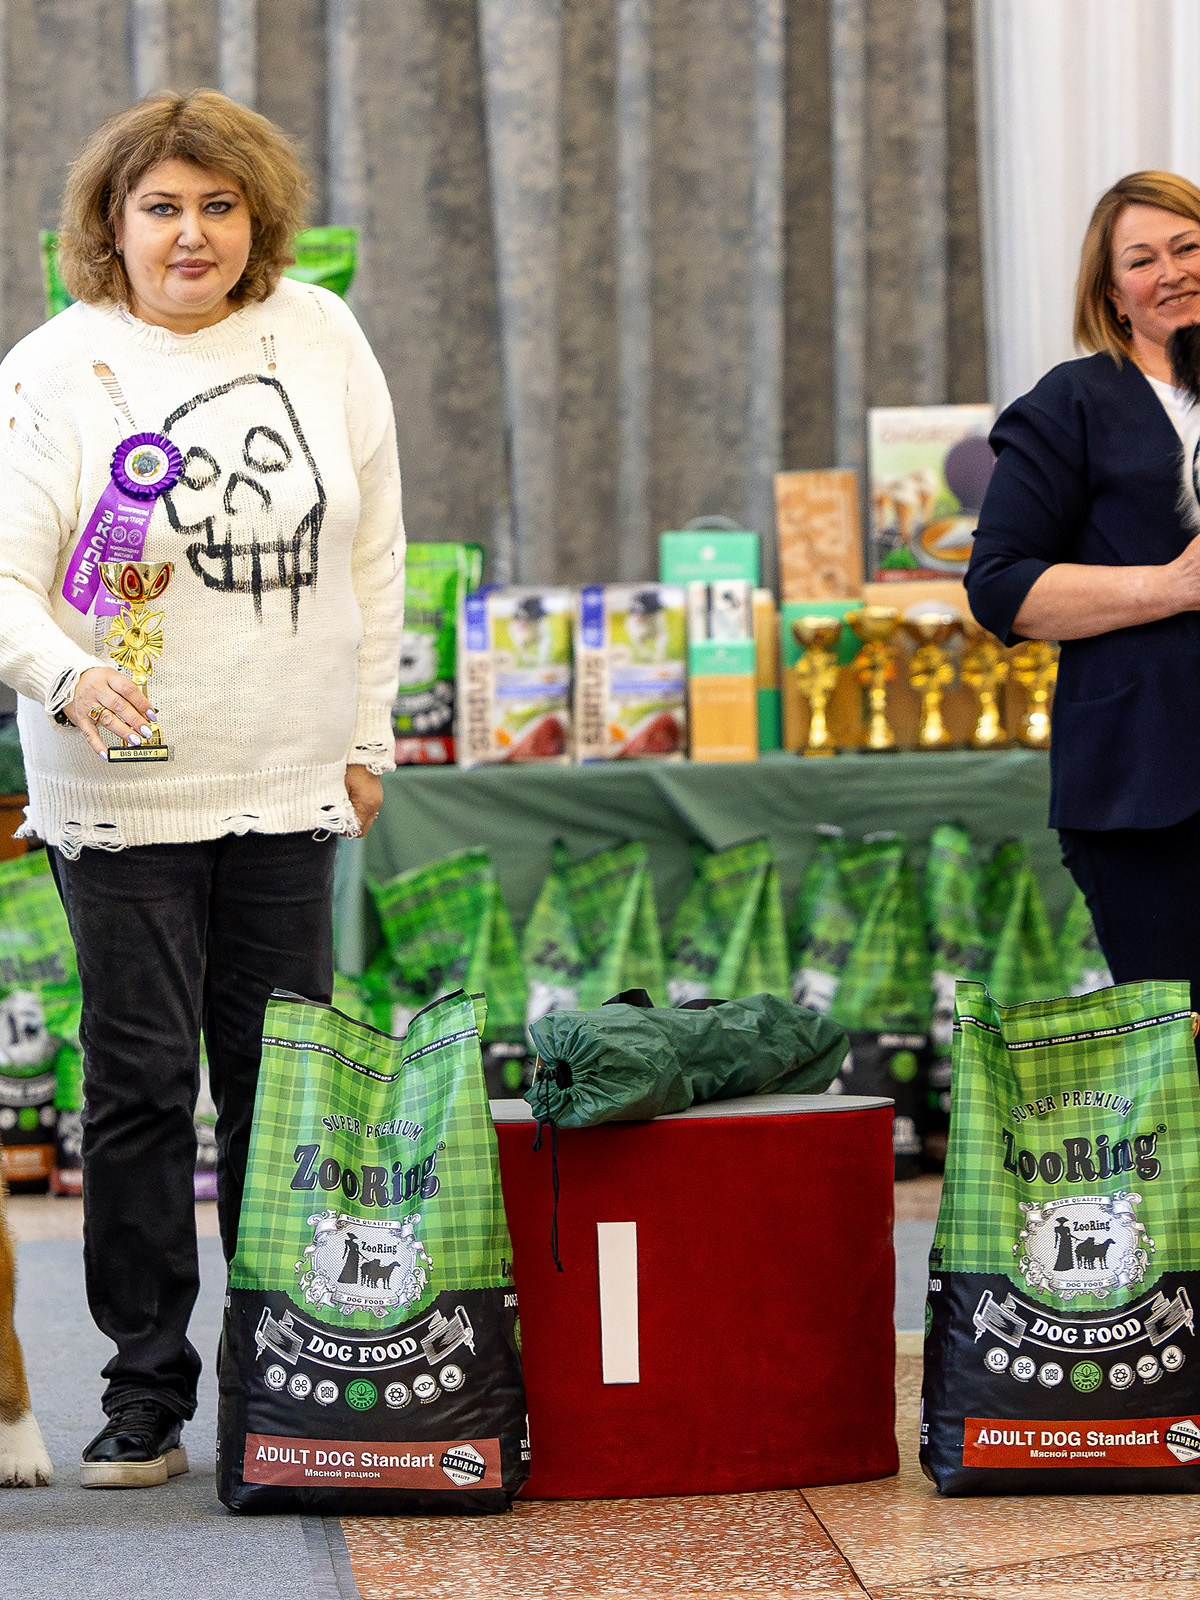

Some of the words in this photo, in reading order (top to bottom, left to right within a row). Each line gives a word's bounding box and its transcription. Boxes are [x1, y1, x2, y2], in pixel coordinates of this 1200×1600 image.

[72, 509, 115, 598] ЭКСПЕРТ
[1010, 1095, 1057, 1123] SUPER
[1062, 1090, 1133, 1118] PREMIUM
[322, 1115, 361, 1135] SUPER
[366, 1119, 424, 1141] PREMIUM
[346, 1216, 360, 1224] HIGH
[1072, 1220, 1111, 1232] ZooRing
[361, 1241, 398, 1255] ZooRing
[1029, 1318, 1079, 1344] DOG
[1083, 1317, 1142, 1345] FOOD
[306, 1335, 352, 1362] DOG
[359, 1336, 419, 1363] FOOD
[977, 1428, 1036, 1447] ADULT
[1040, 1430, 1081, 1447] DOG
[1086, 1429, 1160, 1446] Standart
[255, 1445, 310, 1464] ADULT
[315, 1449, 355, 1467] DOG
[360, 1451, 434, 1468] Standart
[454, 1450, 478, 1460] PREMIUM
[1030, 1449, 1067, 1458] Мясной
[1070, 1450, 1106, 1459] рацион
[304, 1468, 342, 1479] Мясной
[345, 1470, 380, 1480] рацион
[442, 1456, 484, 1475] СТАНДАРТ
